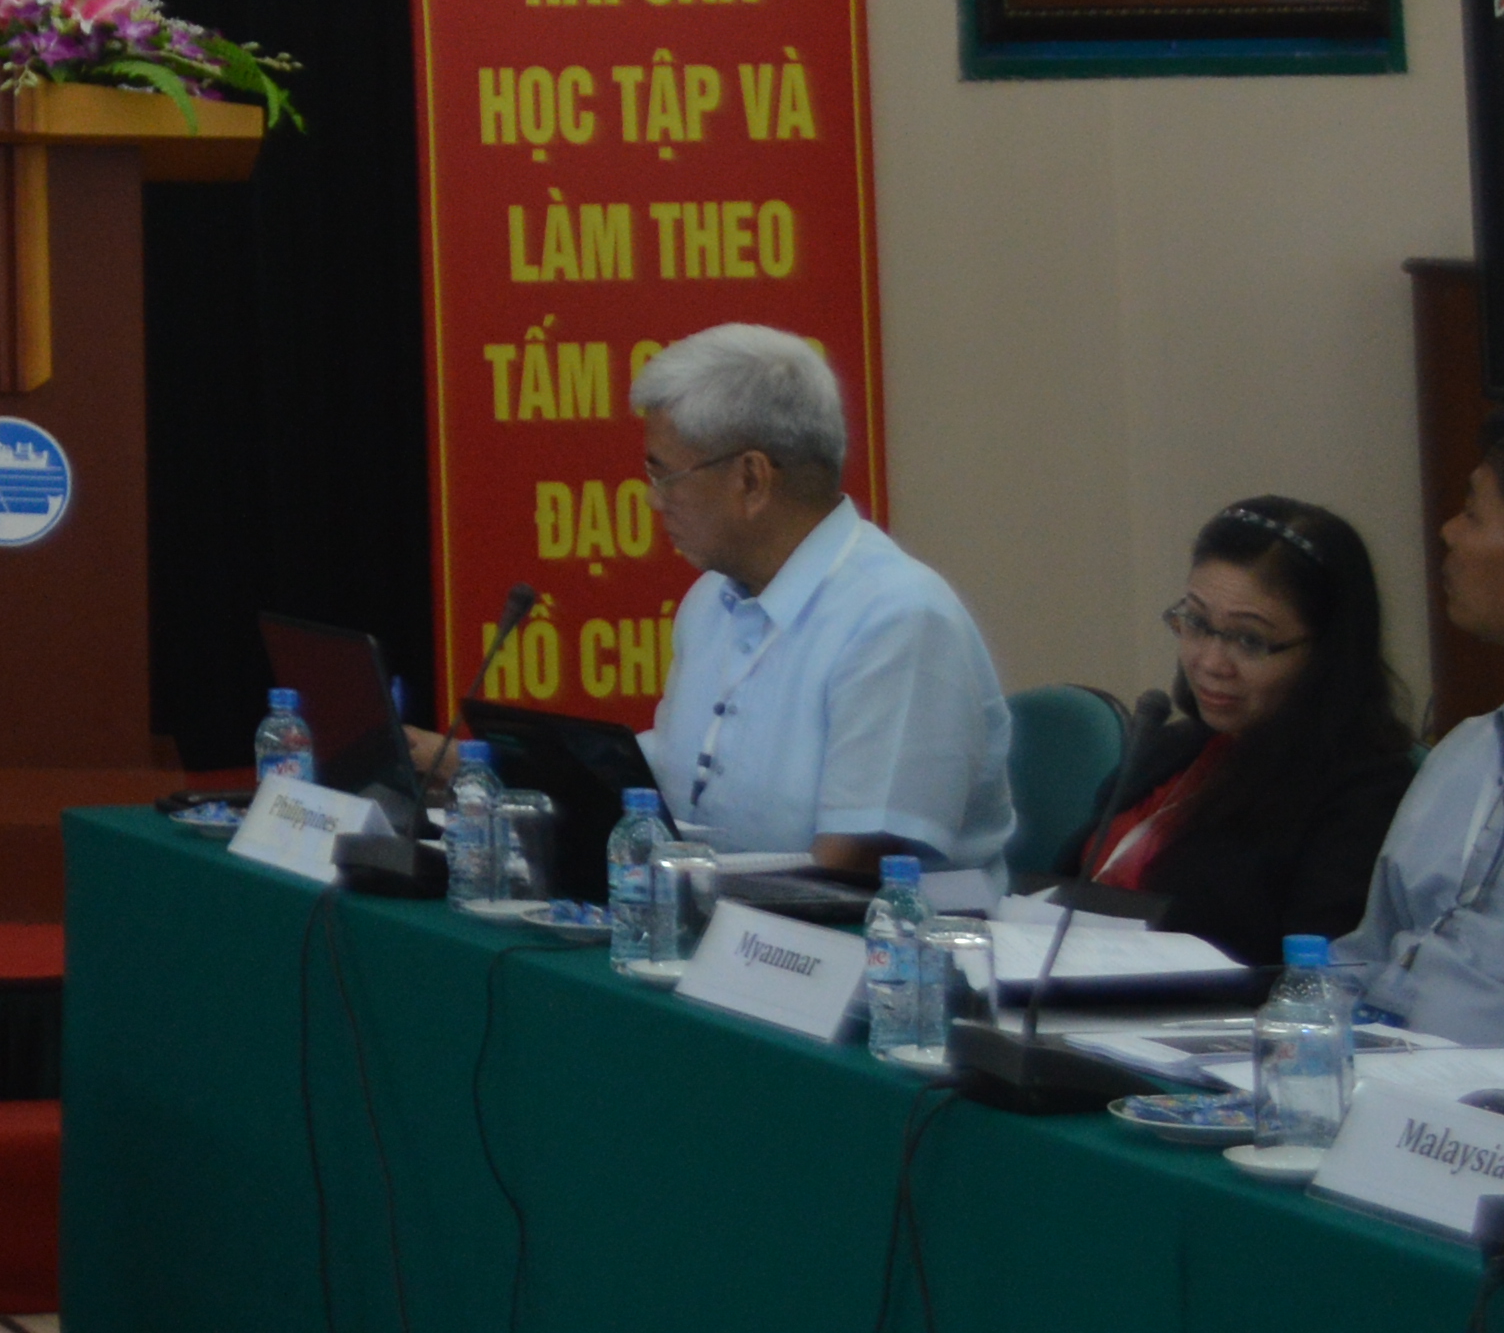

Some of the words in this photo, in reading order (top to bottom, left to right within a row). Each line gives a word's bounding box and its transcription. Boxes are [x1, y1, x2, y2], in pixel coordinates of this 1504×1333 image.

[480, 66, 596, 161] HỌC
[613, 49, 722, 159] TẬP
[740, 47, 816, 140] VÀ
[510, 188, 634, 282] LÀM
[651, 200, 795, 278] THEO
[485, 315, 612, 420] TẤM
[536, 480, 653, 575] ĐẠO
[483, 594, 561, 699] HỒ
[269, 794, 339, 832] Philippines
[735, 932, 821, 976] Myanmar
